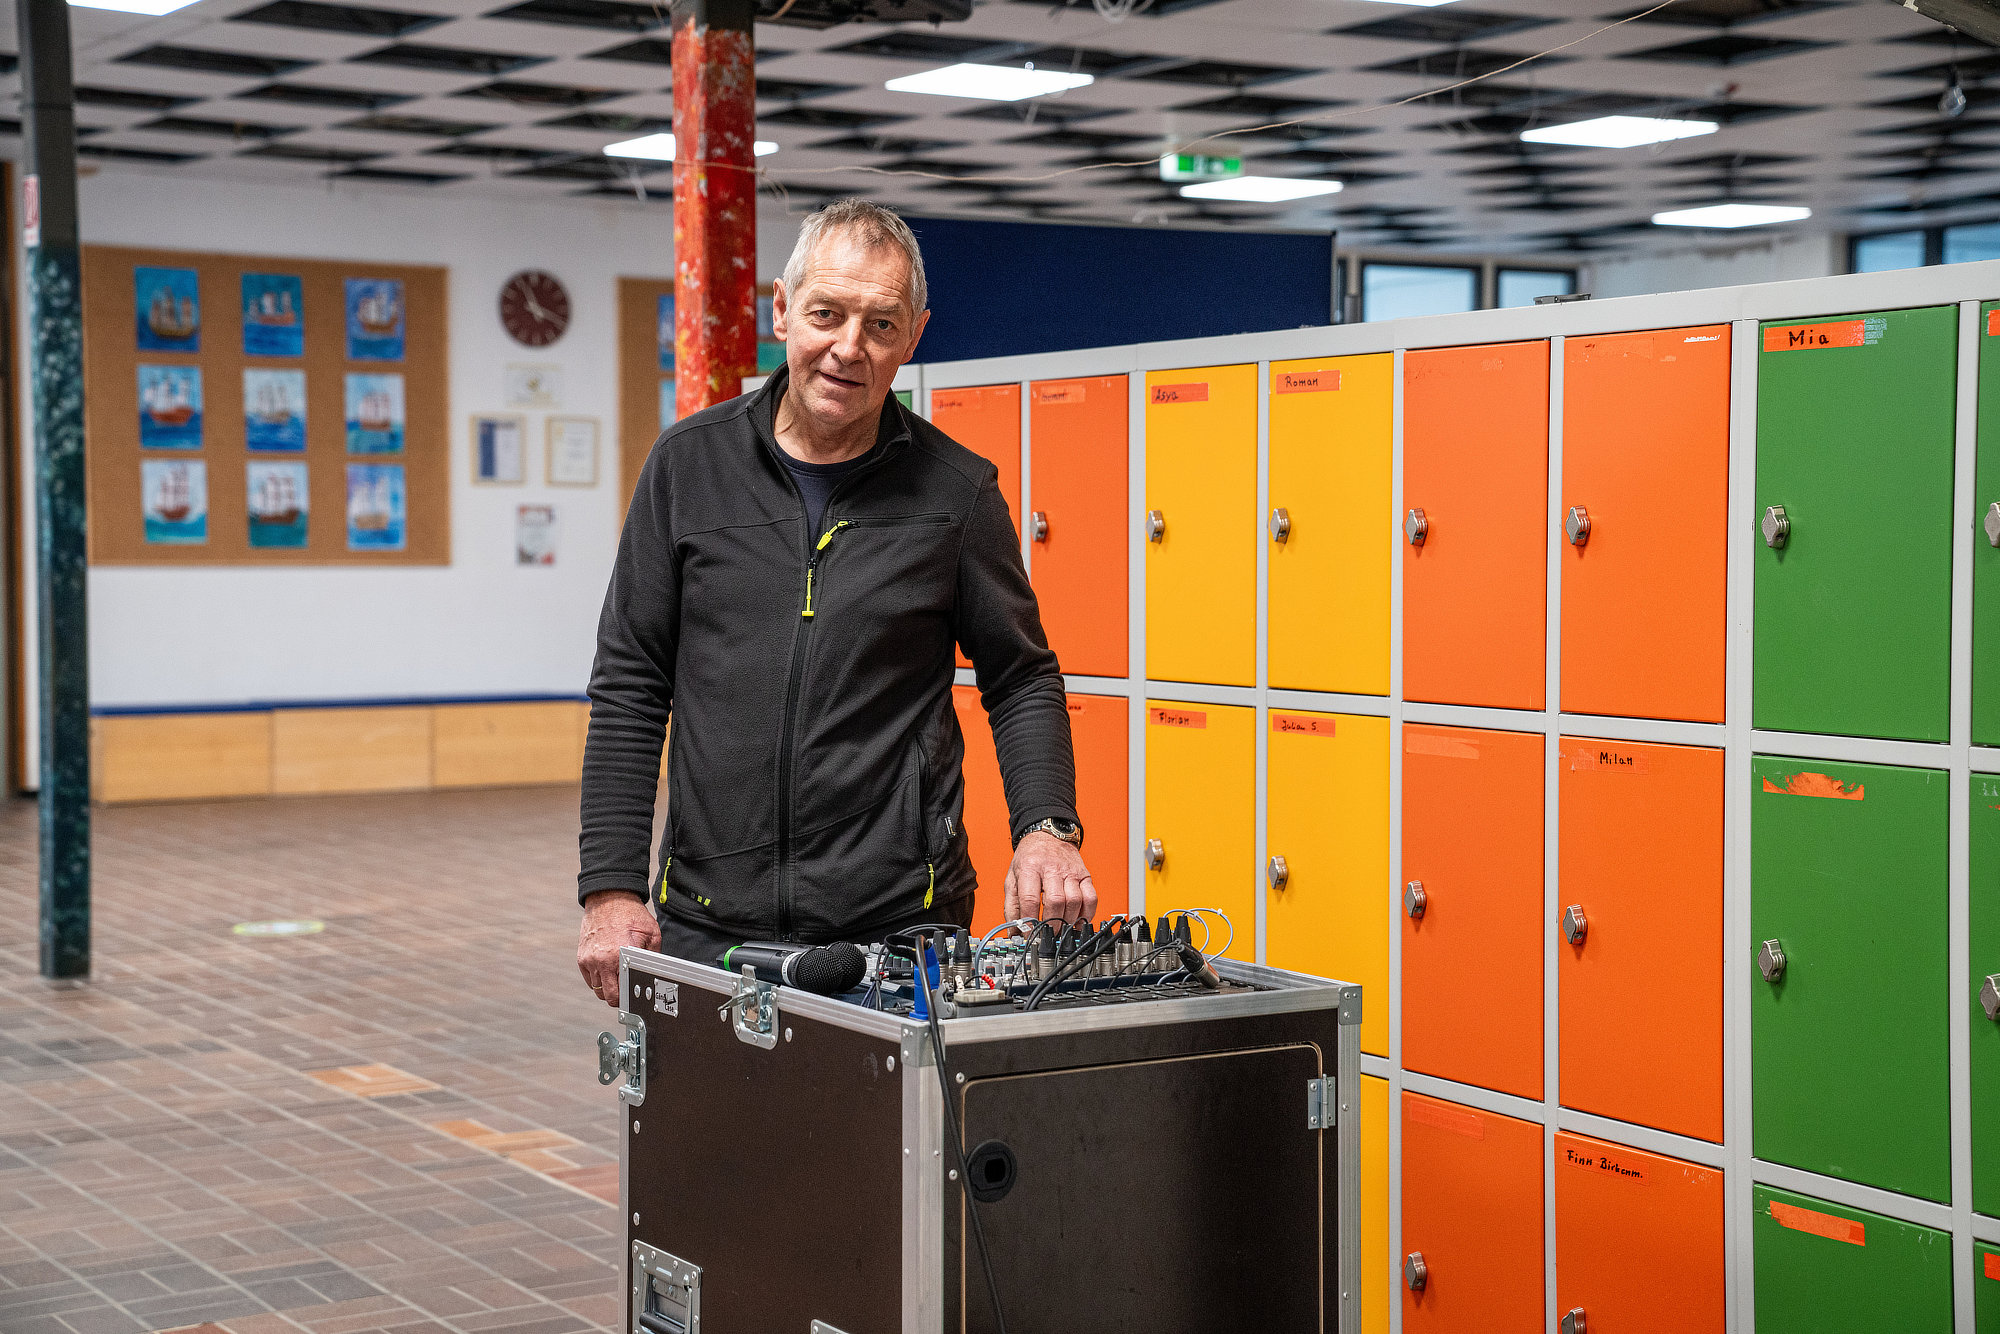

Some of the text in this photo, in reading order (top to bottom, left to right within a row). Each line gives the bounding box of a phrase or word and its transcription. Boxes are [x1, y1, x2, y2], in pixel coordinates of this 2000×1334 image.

[1788, 329, 1830, 347] Mia
[1284, 375, 1319, 389] Roman
[1158, 711, 1190, 726] Florian
[1599, 751, 1633, 766] Milan
[1566, 1149, 1593, 1166] Finn
